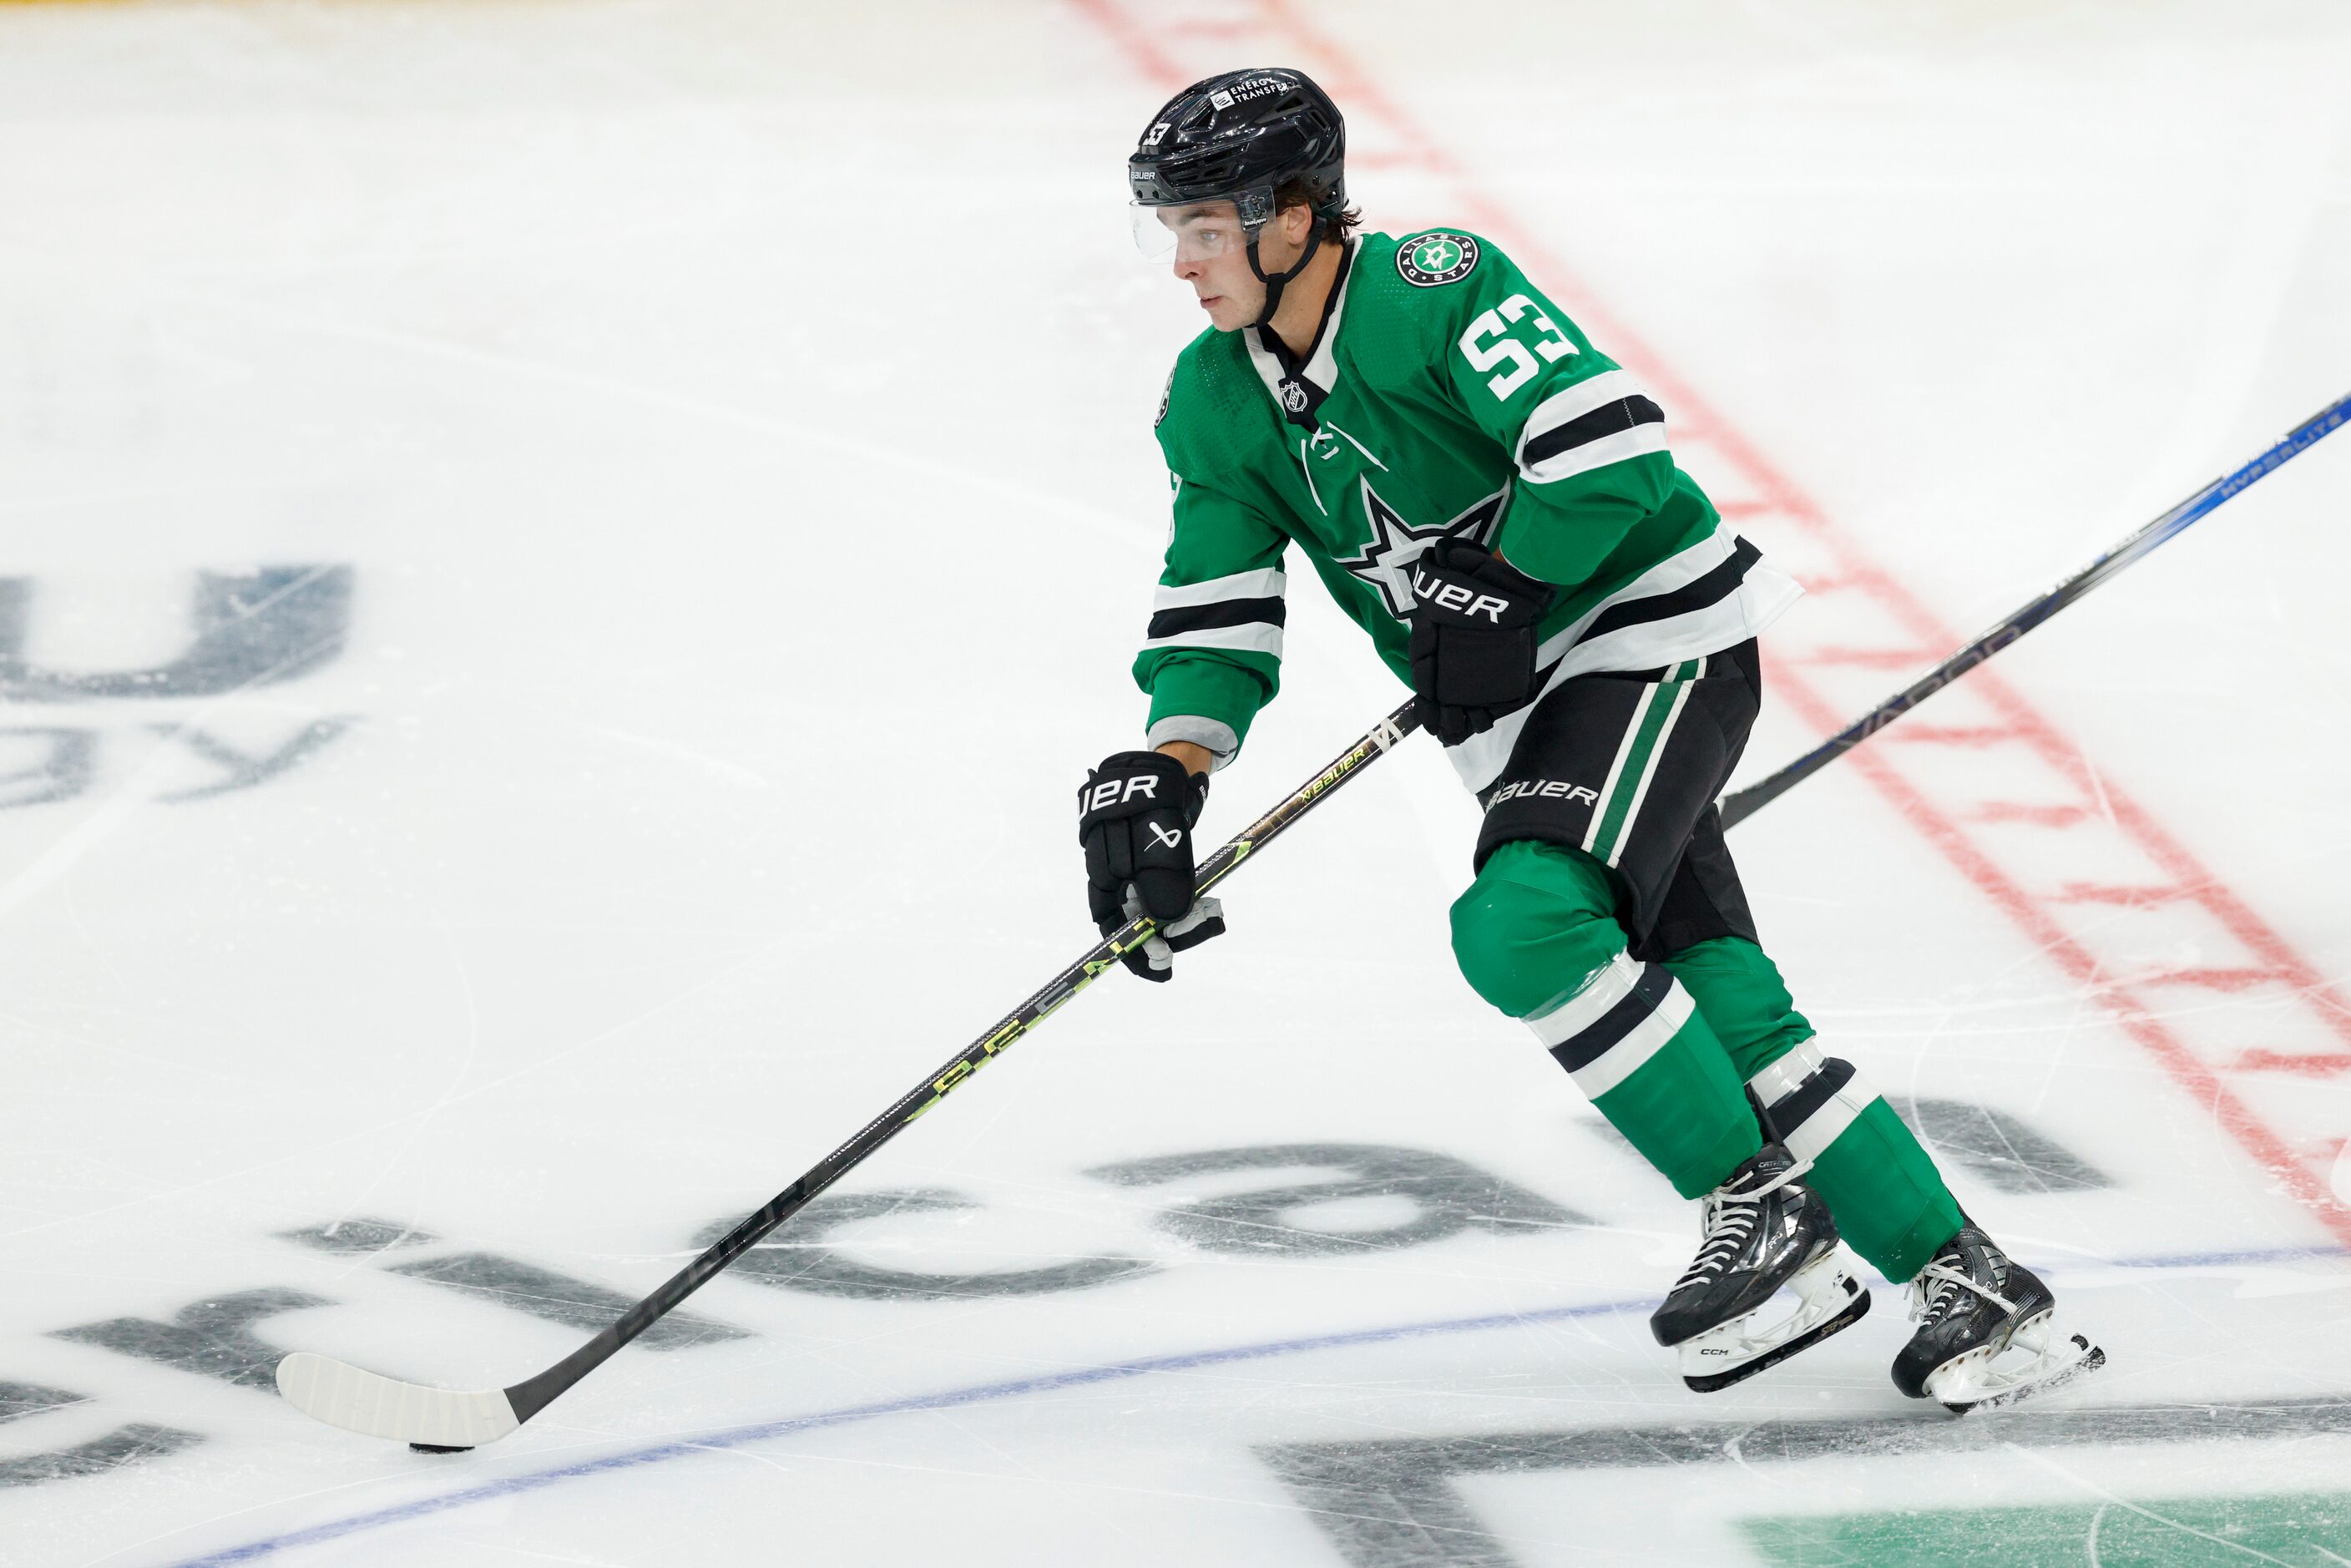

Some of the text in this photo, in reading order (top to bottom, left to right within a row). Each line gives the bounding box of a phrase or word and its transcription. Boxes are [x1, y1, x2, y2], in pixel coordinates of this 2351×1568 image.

[1230, 77, 1273, 95] ENERGY
[1402, 235, 1473, 281] DALLAS STARS
[1458, 294, 1580, 402] 53
[1289, 387, 1299, 408] NHL
